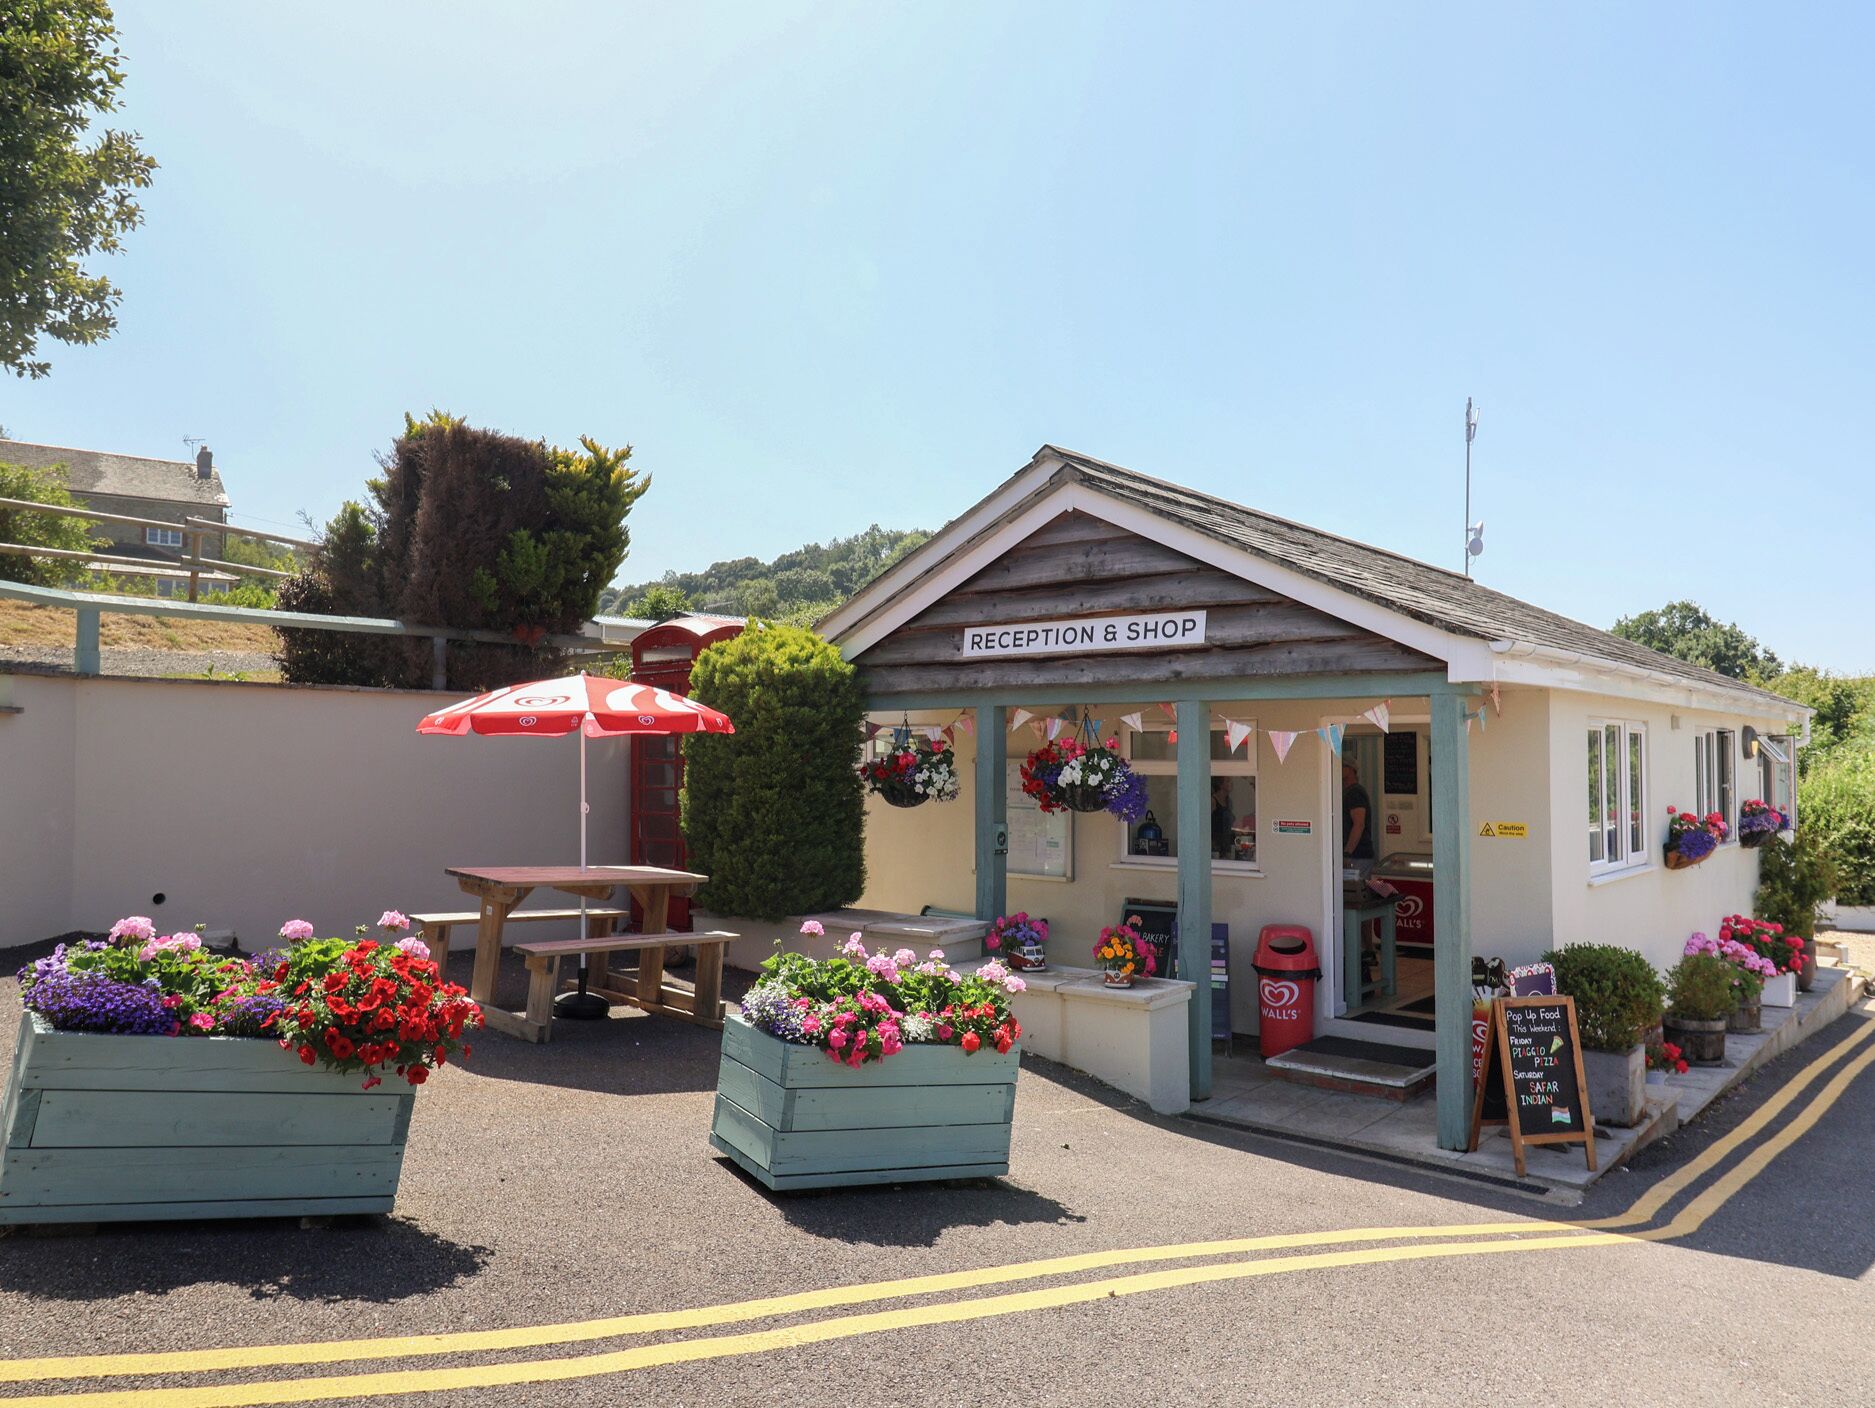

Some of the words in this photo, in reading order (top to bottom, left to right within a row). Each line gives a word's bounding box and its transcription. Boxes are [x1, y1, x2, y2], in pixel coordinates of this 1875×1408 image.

[971, 626, 1095, 650] RECEPTION
[1103, 624, 1117, 642] &
[1126, 618, 1197, 641] SHOP
[1396, 919, 1422, 929] ALL'S
[1142, 932, 1170, 943] BAKERY
[1261, 1006, 1297, 1020] WALL'S
[1506, 1010, 1522, 1024] Pop
[1525, 1009, 1537, 1023] Up
[1540, 1007, 1561, 1020] Food
[1512, 1024, 1527, 1033] This
[1509, 1036, 1532, 1045] FRIDAY
[1512, 1046, 1546, 1058] PIAGGIO
[1534, 1056, 1559, 1067] PIZZA
[1513, 1070, 1544, 1079] SATURDAY
[1529, 1081, 1559, 1093] SAFAR
[1520, 1095, 1553, 1105] INDIAN
